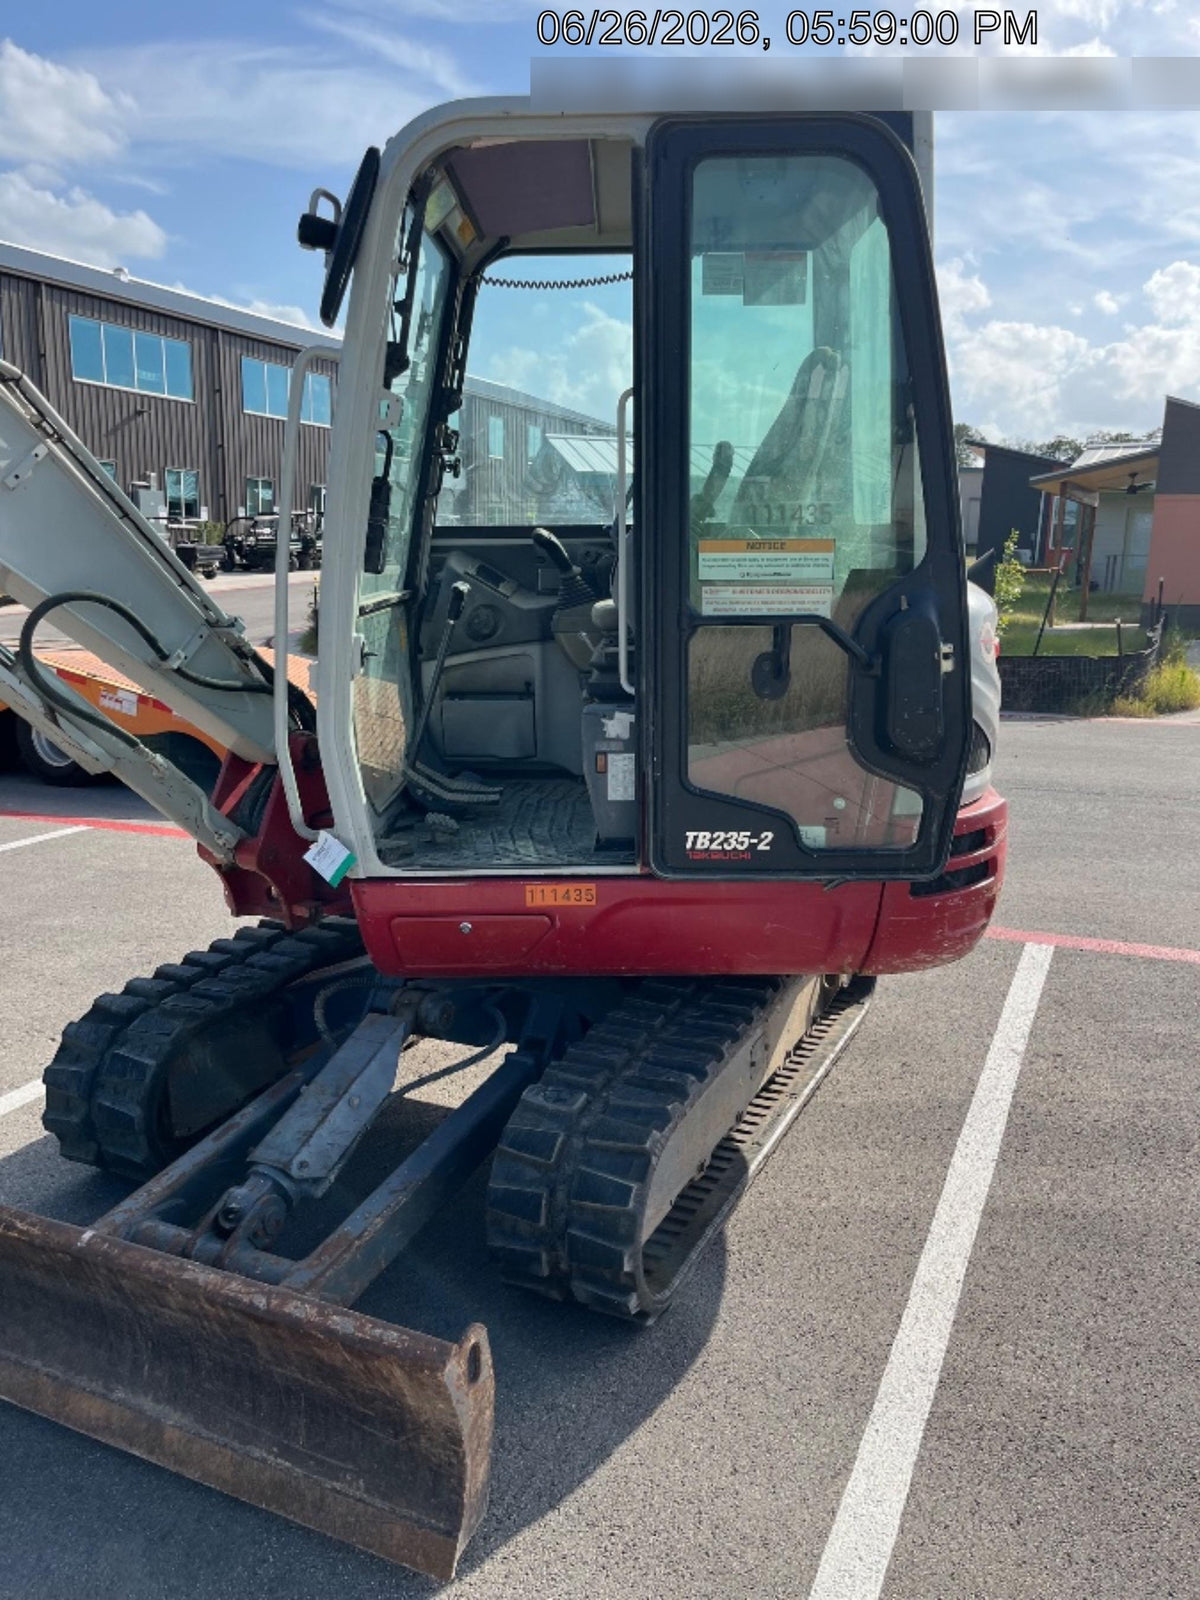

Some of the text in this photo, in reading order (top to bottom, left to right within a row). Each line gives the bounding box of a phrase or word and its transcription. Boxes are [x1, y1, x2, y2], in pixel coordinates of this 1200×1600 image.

[746, 542, 786, 550] NOTICE
[685, 831, 774, 851] TB235-2
[685, 851, 751, 861] TAKEUCHI
[529, 888, 594, 903] 111435
